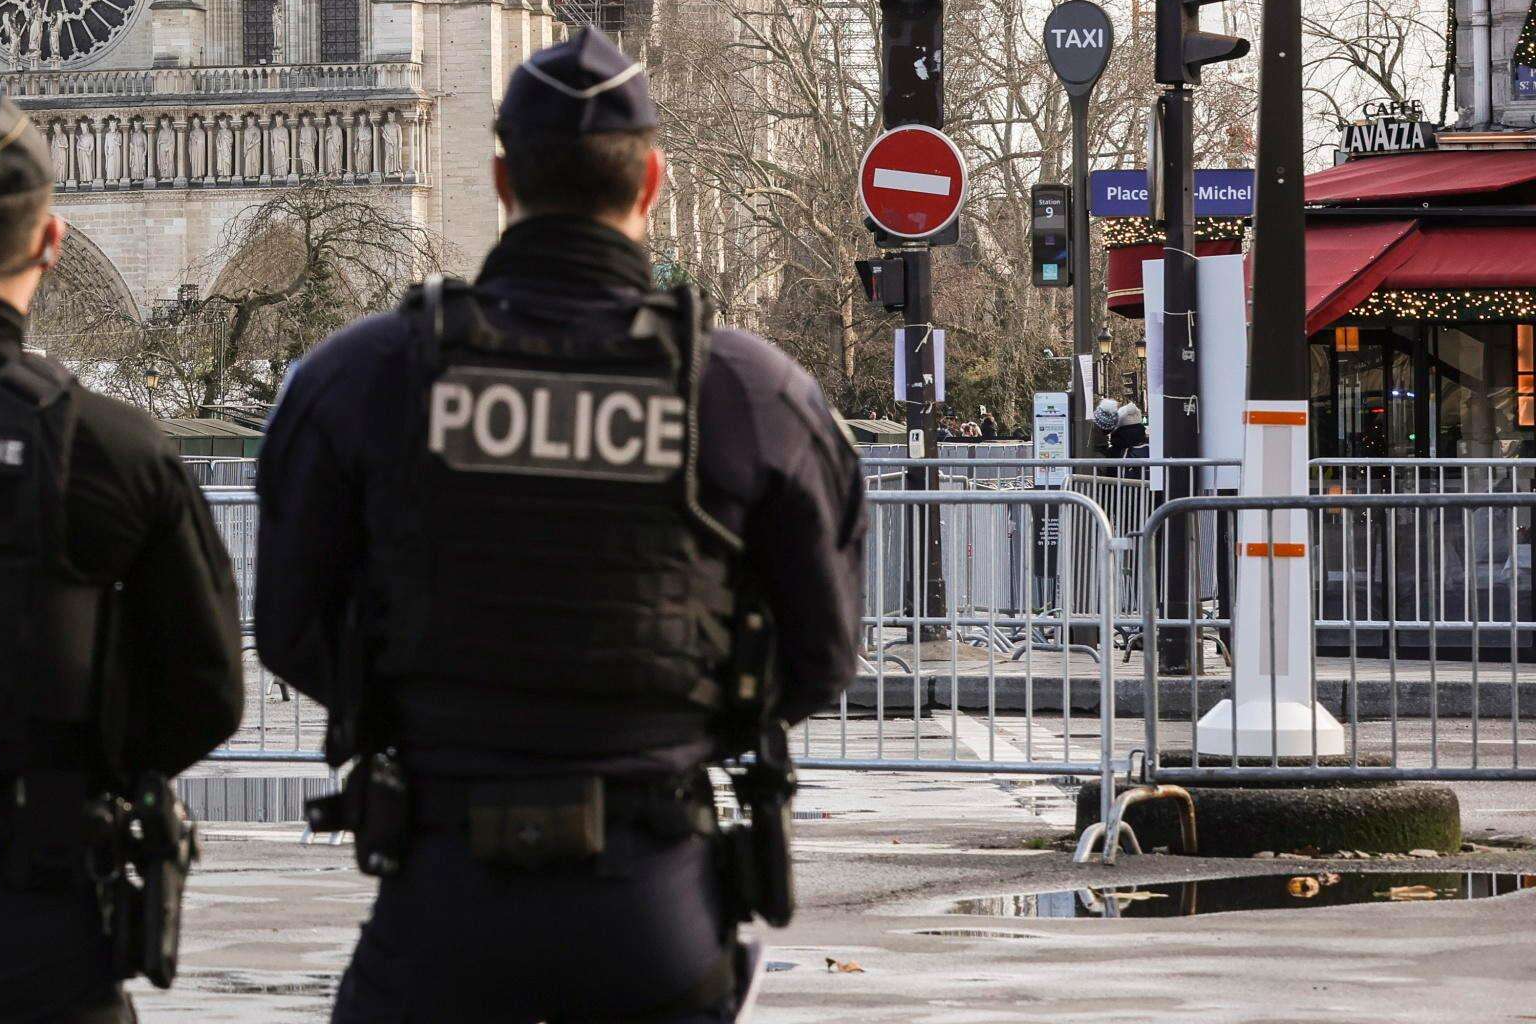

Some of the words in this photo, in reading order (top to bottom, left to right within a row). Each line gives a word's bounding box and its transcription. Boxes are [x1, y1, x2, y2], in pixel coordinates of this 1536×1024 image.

[1051, 28, 1104, 49] TAXI
[1340, 117, 1425, 153] LAVAZZA
[1106, 186, 1149, 200] Place
[1193, 185, 1252, 200] -Michel
[1045, 207, 1054, 218] 9
[428, 382, 686, 467] POLICE
